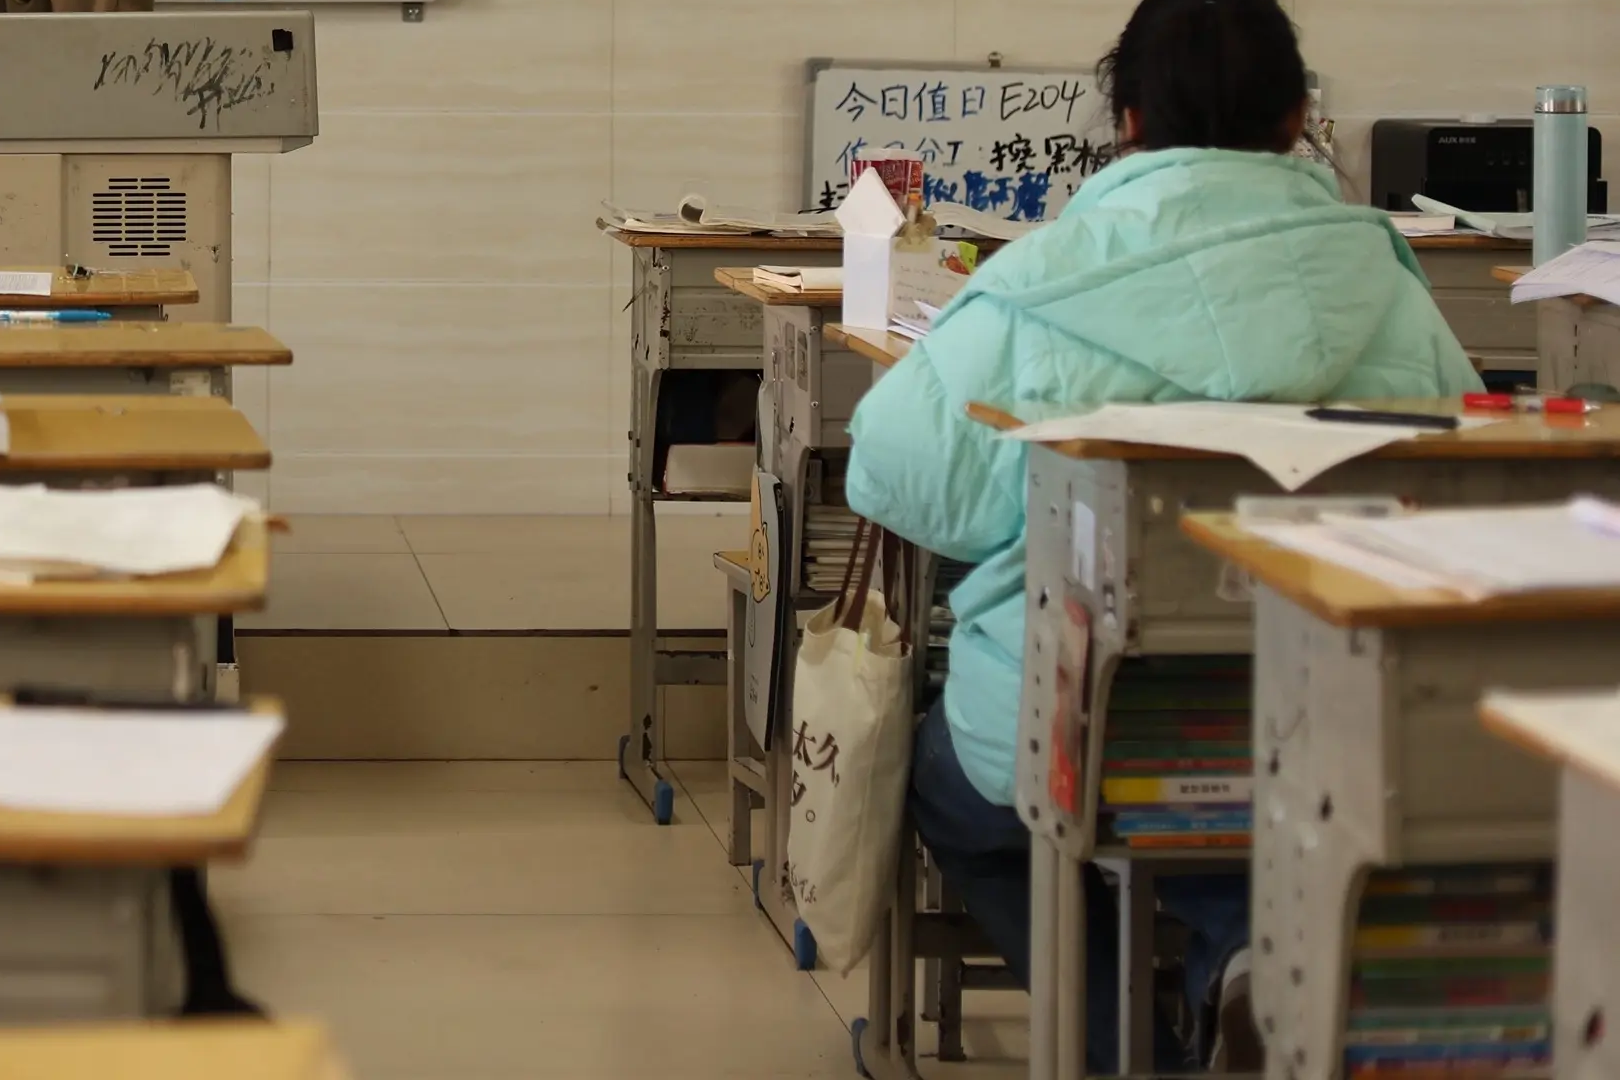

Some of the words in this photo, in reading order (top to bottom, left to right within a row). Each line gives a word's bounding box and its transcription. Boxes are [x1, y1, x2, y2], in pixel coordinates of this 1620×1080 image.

[836, 81, 986, 123] 今日值日
[999, 80, 1086, 124] E204
